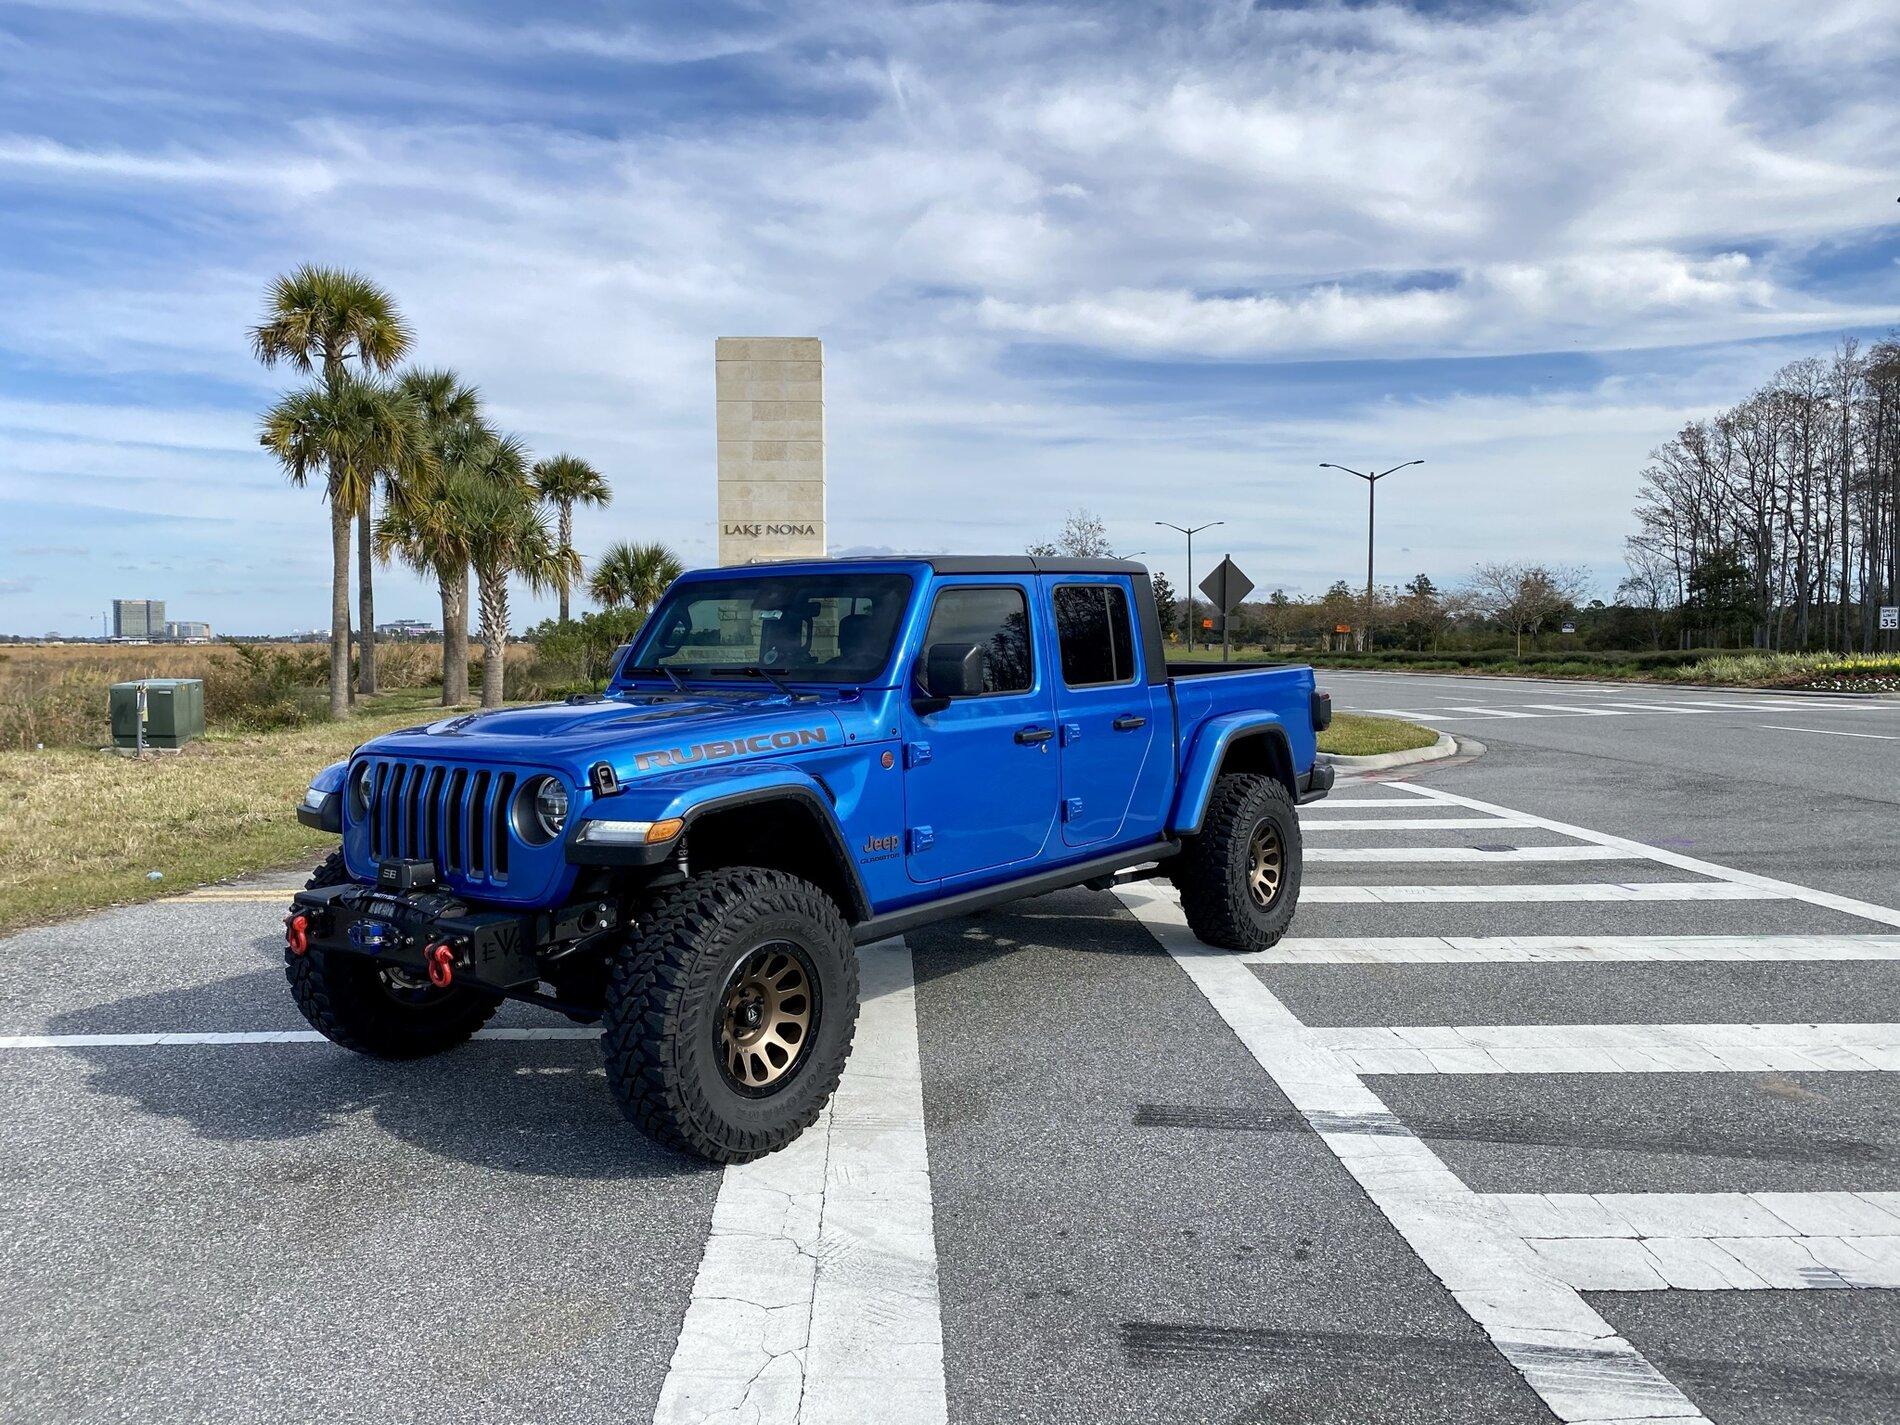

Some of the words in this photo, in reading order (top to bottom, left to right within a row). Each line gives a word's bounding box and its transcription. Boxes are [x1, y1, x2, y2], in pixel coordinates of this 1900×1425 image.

[724, 524, 762, 538] LAKE
[766, 524, 815, 535] NONA
[1882, 619, 1897, 627] 35
[634, 727, 827, 771] RUBICON
[863, 834, 899, 853] Jeep
